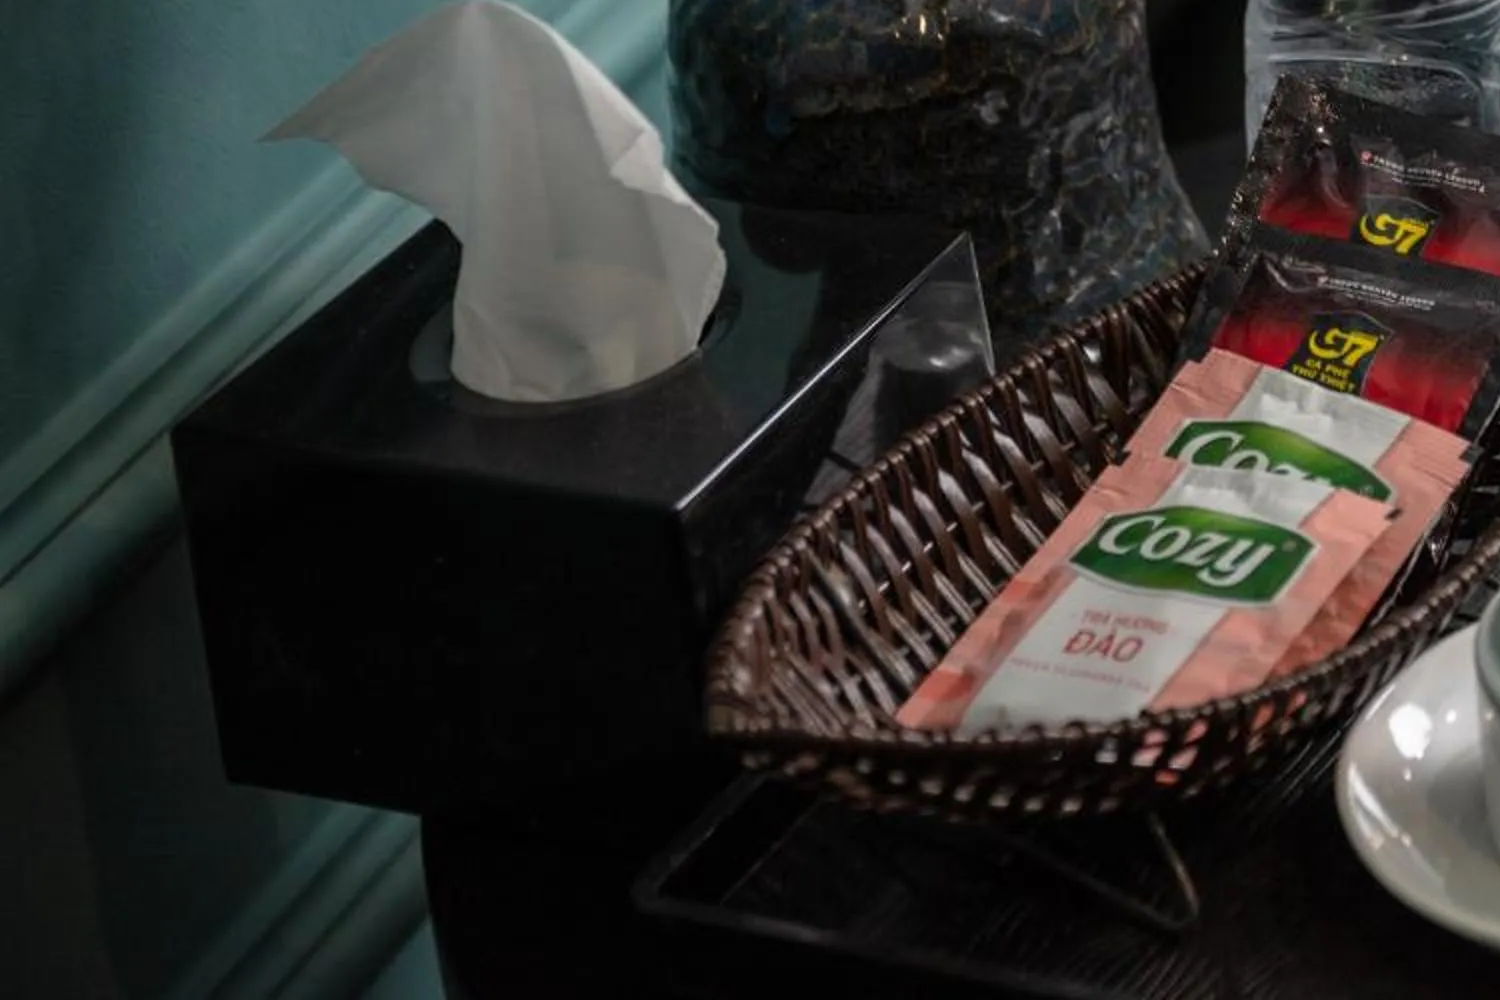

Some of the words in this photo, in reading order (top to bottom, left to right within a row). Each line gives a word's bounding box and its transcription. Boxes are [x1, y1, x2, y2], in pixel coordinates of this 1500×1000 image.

[1359, 213, 1430, 255] G7
[1308, 327, 1379, 368] G7
[1176, 430, 1332, 486] Co
[1098, 515, 1276, 587] Cozy
